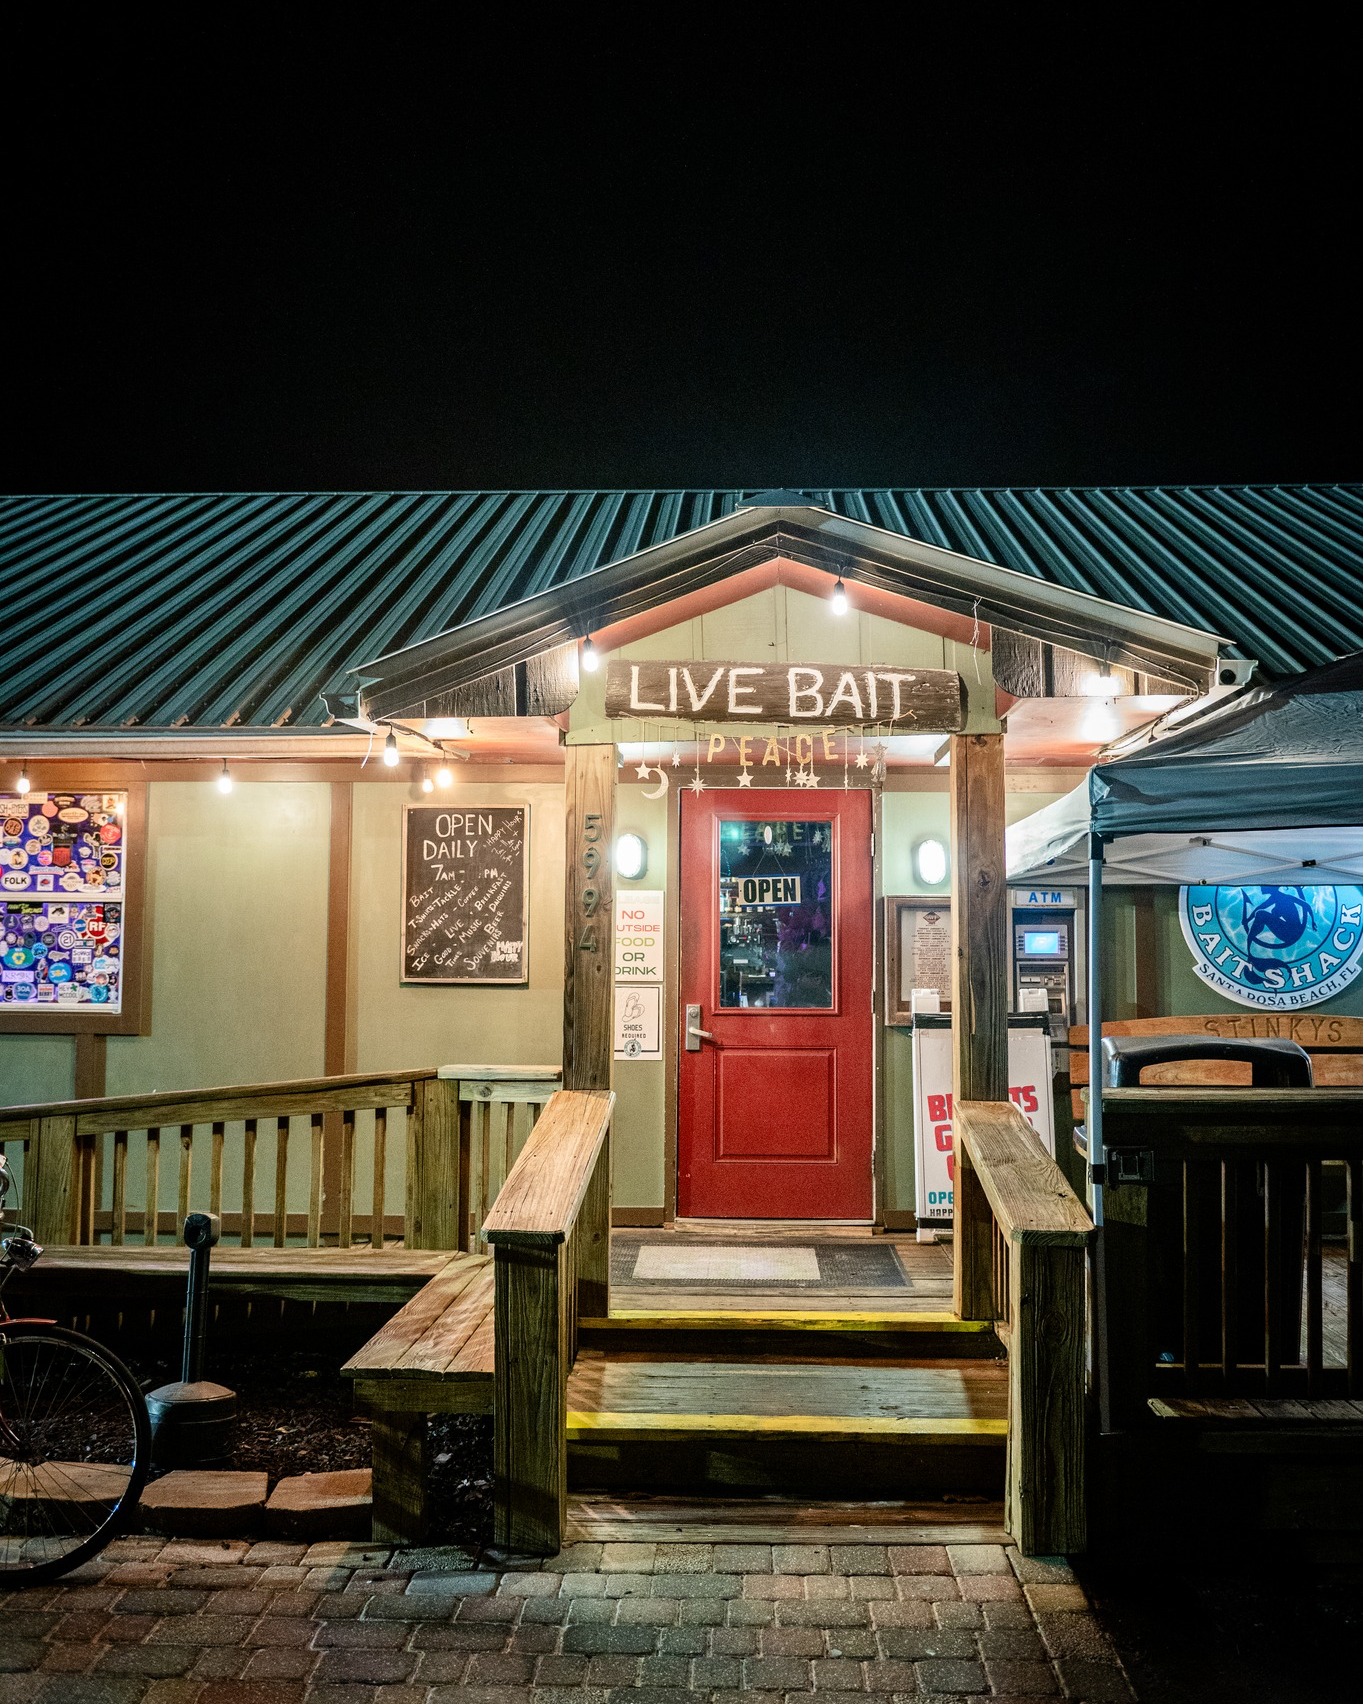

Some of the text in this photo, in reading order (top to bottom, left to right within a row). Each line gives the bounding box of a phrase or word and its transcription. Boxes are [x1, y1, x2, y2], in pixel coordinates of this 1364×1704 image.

[630, 665, 916, 720] LIVE BAIT
[706, 729, 839, 767] PEACE
[435, 813, 493, 838] OPEN
[423, 839, 478, 861] DAILY
[4, 877, 27, 885] FOLK
[474, 872, 507, 911] BREAKFAST
[579, 813, 603, 953] 5994
[743, 878, 797, 903] OPEN
[409, 887, 434, 907] BAIT
[1028, 891, 1062, 903] ATM
[484, 911, 505, 935] BEER
[621, 910, 645, 920] NO
[444, 919, 464, 939] LIVE
[459, 919, 482, 943] MUSIC
[616, 924, 661, 933] UTSIDE
[63, 936, 72, 944] 21
[1192, 903, 1362, 989] BAIT SHACK
[412, 952, 430, 971] ICE
[622, 952, 646, 962] OR
[615, 966, 657, 975] DRINK
[1200, 963, 1242, 995] SANTA
[1290, 980, 1342, 1005] BEACH,
[1343, 967, 1358, 981] FL
[1204, 1017, 1343, 1043] STINKYS
[928, 1191, 953, 1204] OPE
[929, 1208, 953, 1217] HAPP
